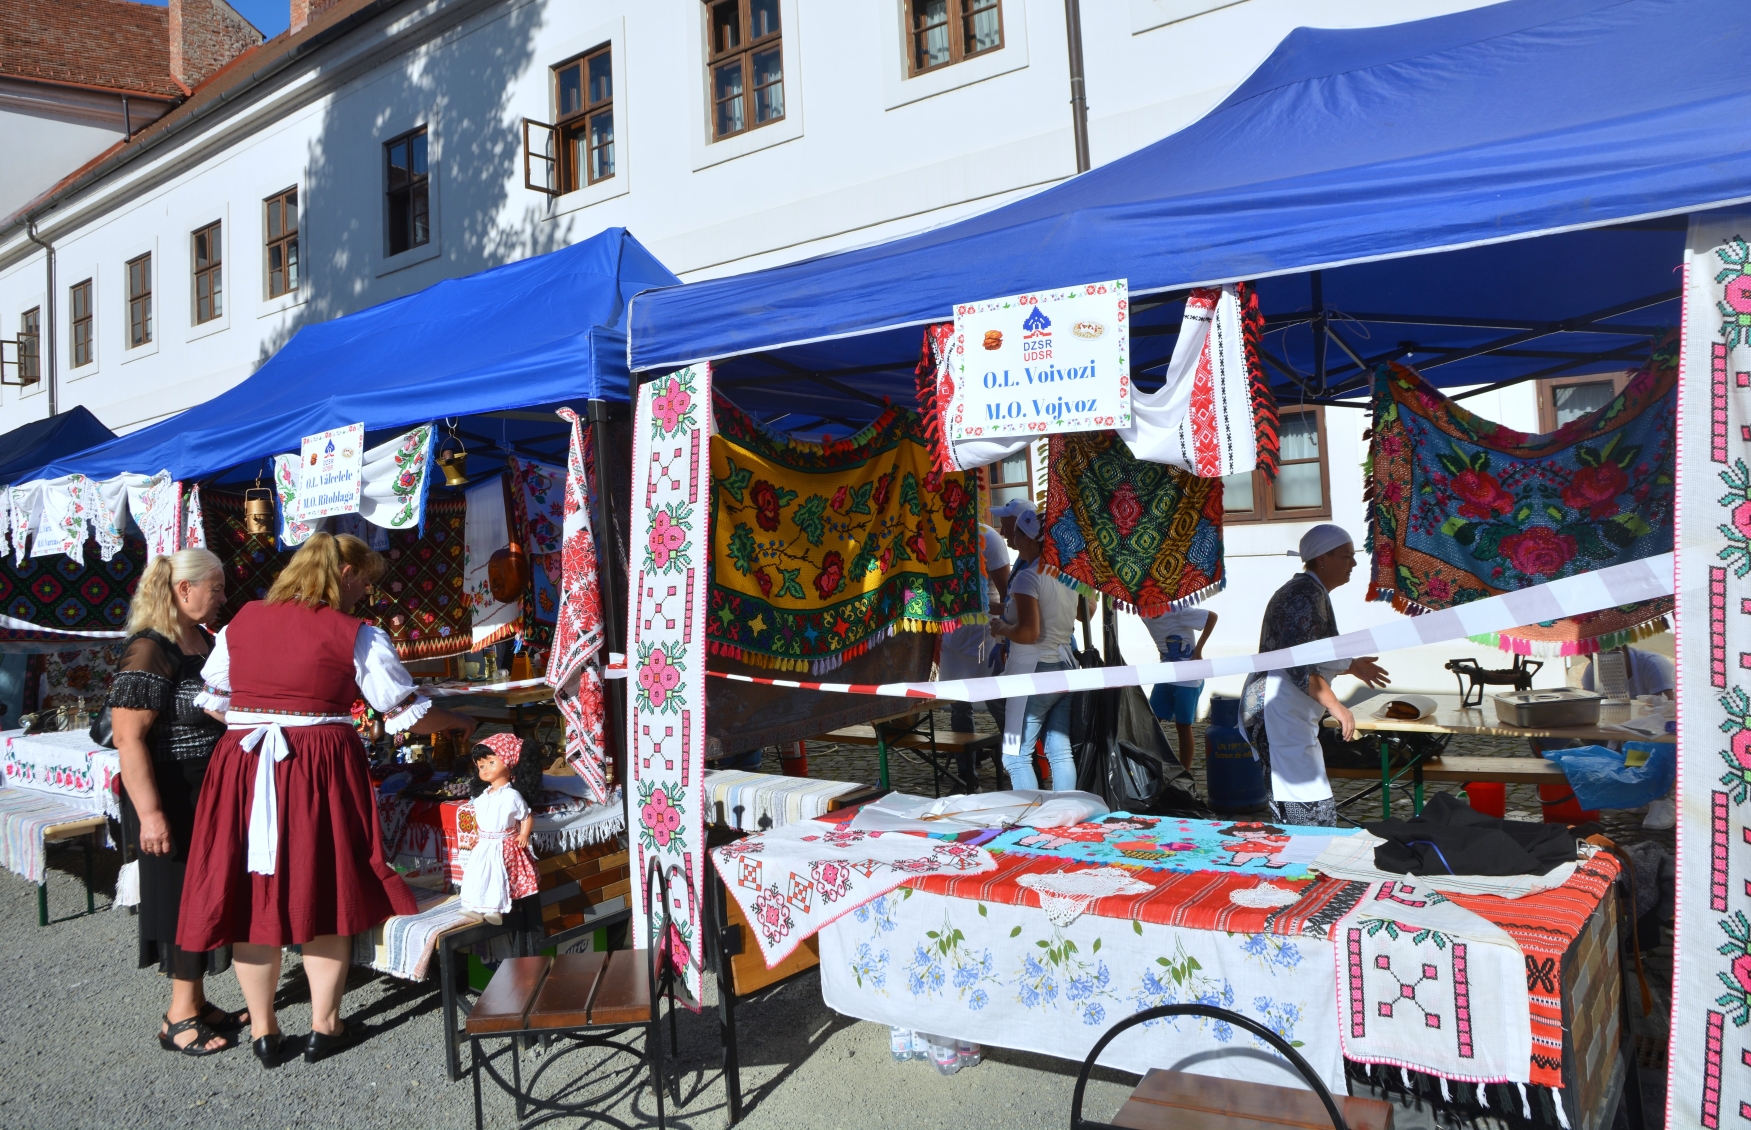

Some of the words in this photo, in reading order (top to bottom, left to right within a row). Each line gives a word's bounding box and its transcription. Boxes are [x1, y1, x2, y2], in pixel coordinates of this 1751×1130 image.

[1023, 339, 1052, 351] DZSR
[1023, 350, 1053, 362] UDSR
[983, 370, 1020, 389] O.L.
[1024, 359, 1096, 385] Voivozi
[985, 401, 1027, 420] M.O.
[1032, 396, 1097, 420] Vojvoz
[306, 477, 318, 489] O.L.
[304, 497, 317, 508] M.O.
